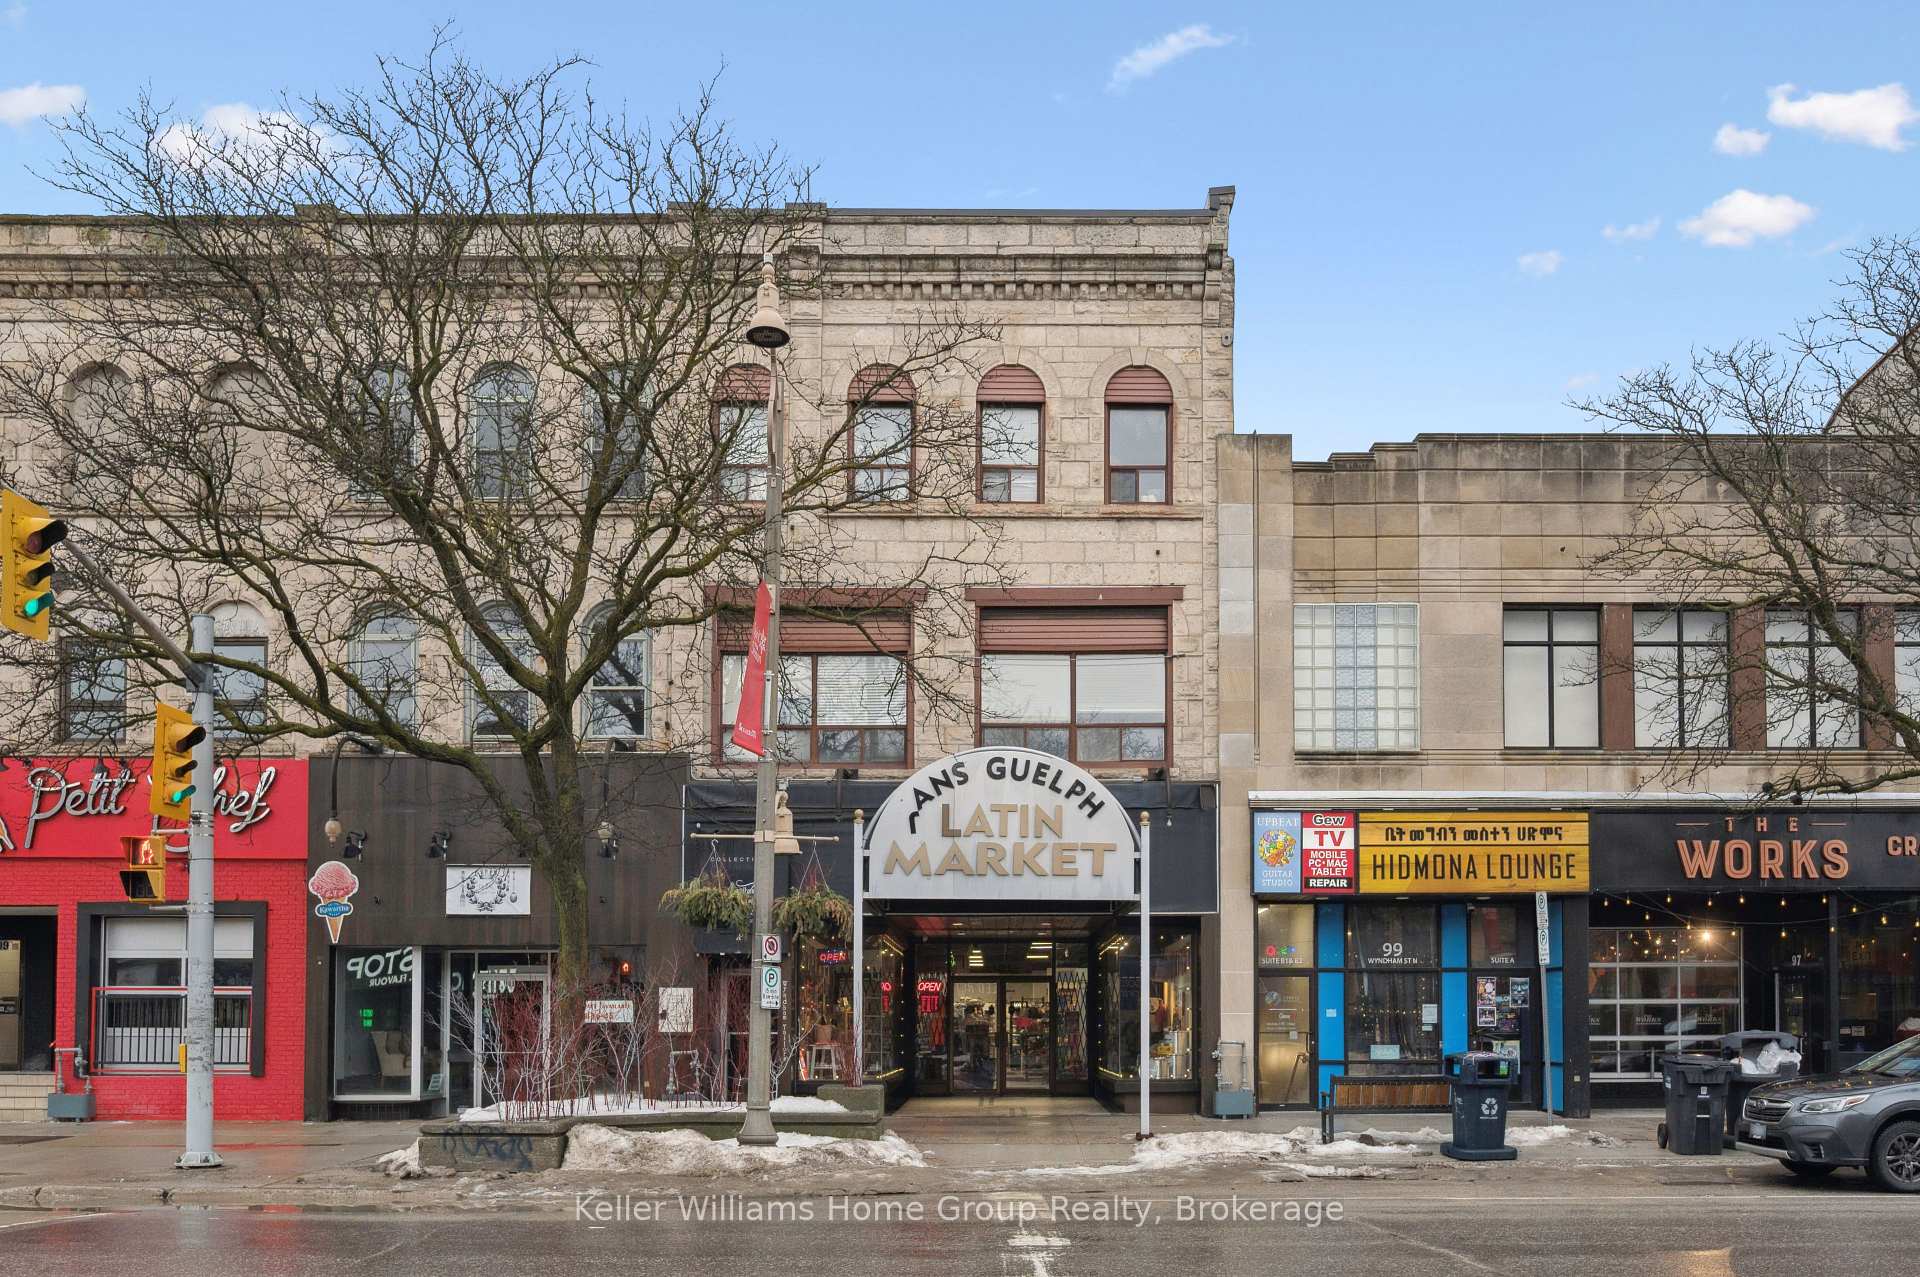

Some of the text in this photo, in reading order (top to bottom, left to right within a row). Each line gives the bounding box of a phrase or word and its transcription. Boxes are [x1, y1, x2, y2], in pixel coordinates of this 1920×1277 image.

[986, 756, 1105, 818] GUELPH
[24, 767, 136, 849] Petit
[941, 803, 1063, 838] LATIN
[1257, 817, 1297, 826] UPBEAT
[1313, 814, 1345, 826] Gew
[1725, 816, 1799, 832] THE
[1314, 831, 1345, 847] TV
[1887, 836, 1920, 856] CR
[883, 840, 1117, 876] MARKET
[1677, 839, 1849, 880] WORKS
[1262, 870, 1293, 878] GUITAR
[1372, 854, 1576, 880] HIDMONA LOUNGE
[1262, 879, 1293, 887] STUDIO
[1309, 879, 1348, 887] REPAIR
[820, 951, 847, 961] OPEN
[1383, 943, 1403, 957] 99
[1792, 955, 1801, 966] 97
[918, 982, 942, 991] OPEN
